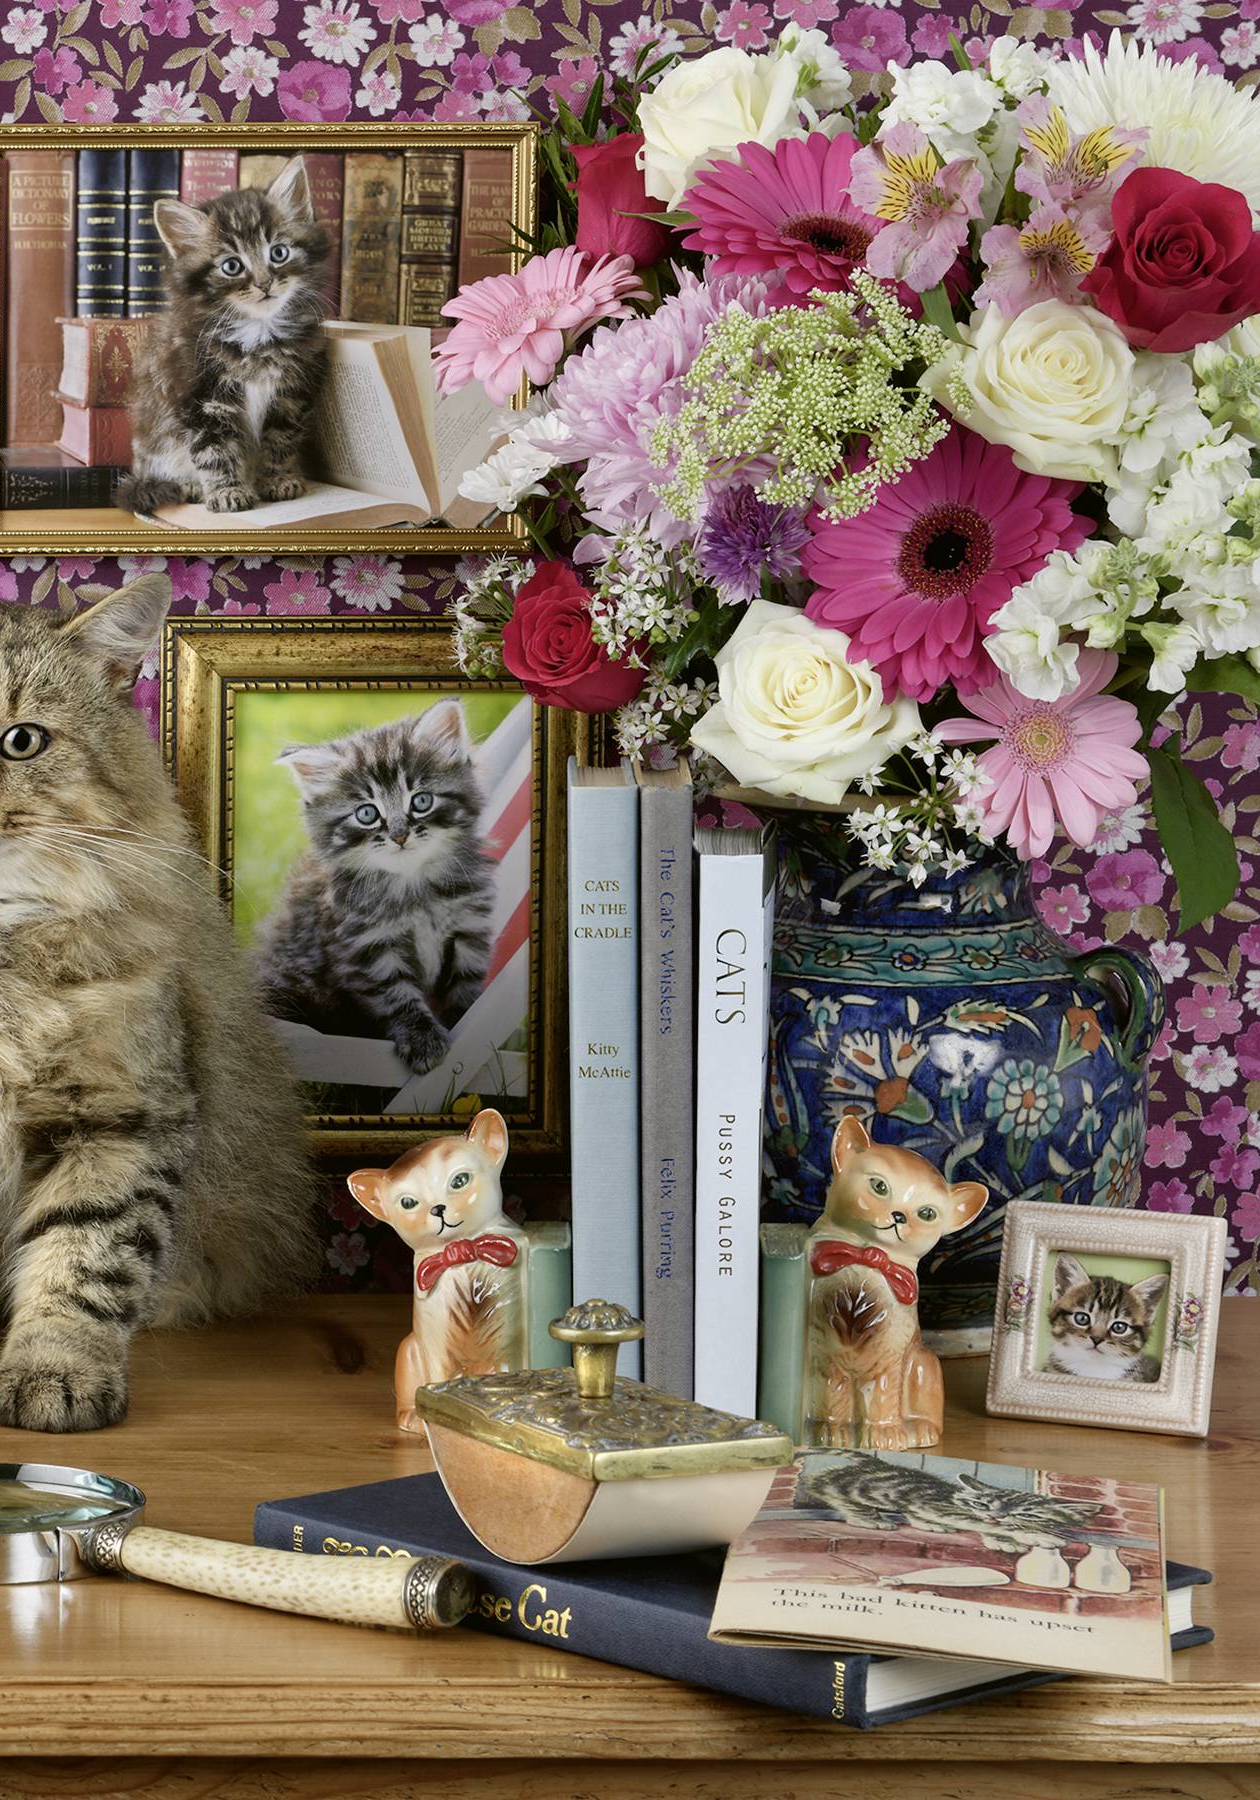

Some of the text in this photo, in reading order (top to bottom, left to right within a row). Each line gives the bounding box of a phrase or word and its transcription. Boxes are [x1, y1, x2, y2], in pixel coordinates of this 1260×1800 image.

[12, 176, 69, 186] A PICTURE
[310, 178, 342, 188] ING'S
[12, 188, 69, 199] DICTIONARY
[12, 212, 69, 224] FLOWERS
[414, 220, 450, 228] GREAT
[584, 880, 621, 892] CATS
[580, 903, 628, 915] IN THE
[574, 926, 632, 939] CRADLE
[659, 848, 677, 1035] The Cat's Whiskers
[714, 928, 748, 1025] CATS
[587, 1043, 620, 1058] Kitty
[578, 1066, 632, 1079] McAttie
[718, 1114, 736, 1278] PUSSY GALORE
[654, 1158, 677, 1280] Felix Purring
[518, 1584, 573, 1639] Cat
[772, 1599, 884, 1616] the milk.
[773, 1588, 1095, 1634] This bad kitten has upset
